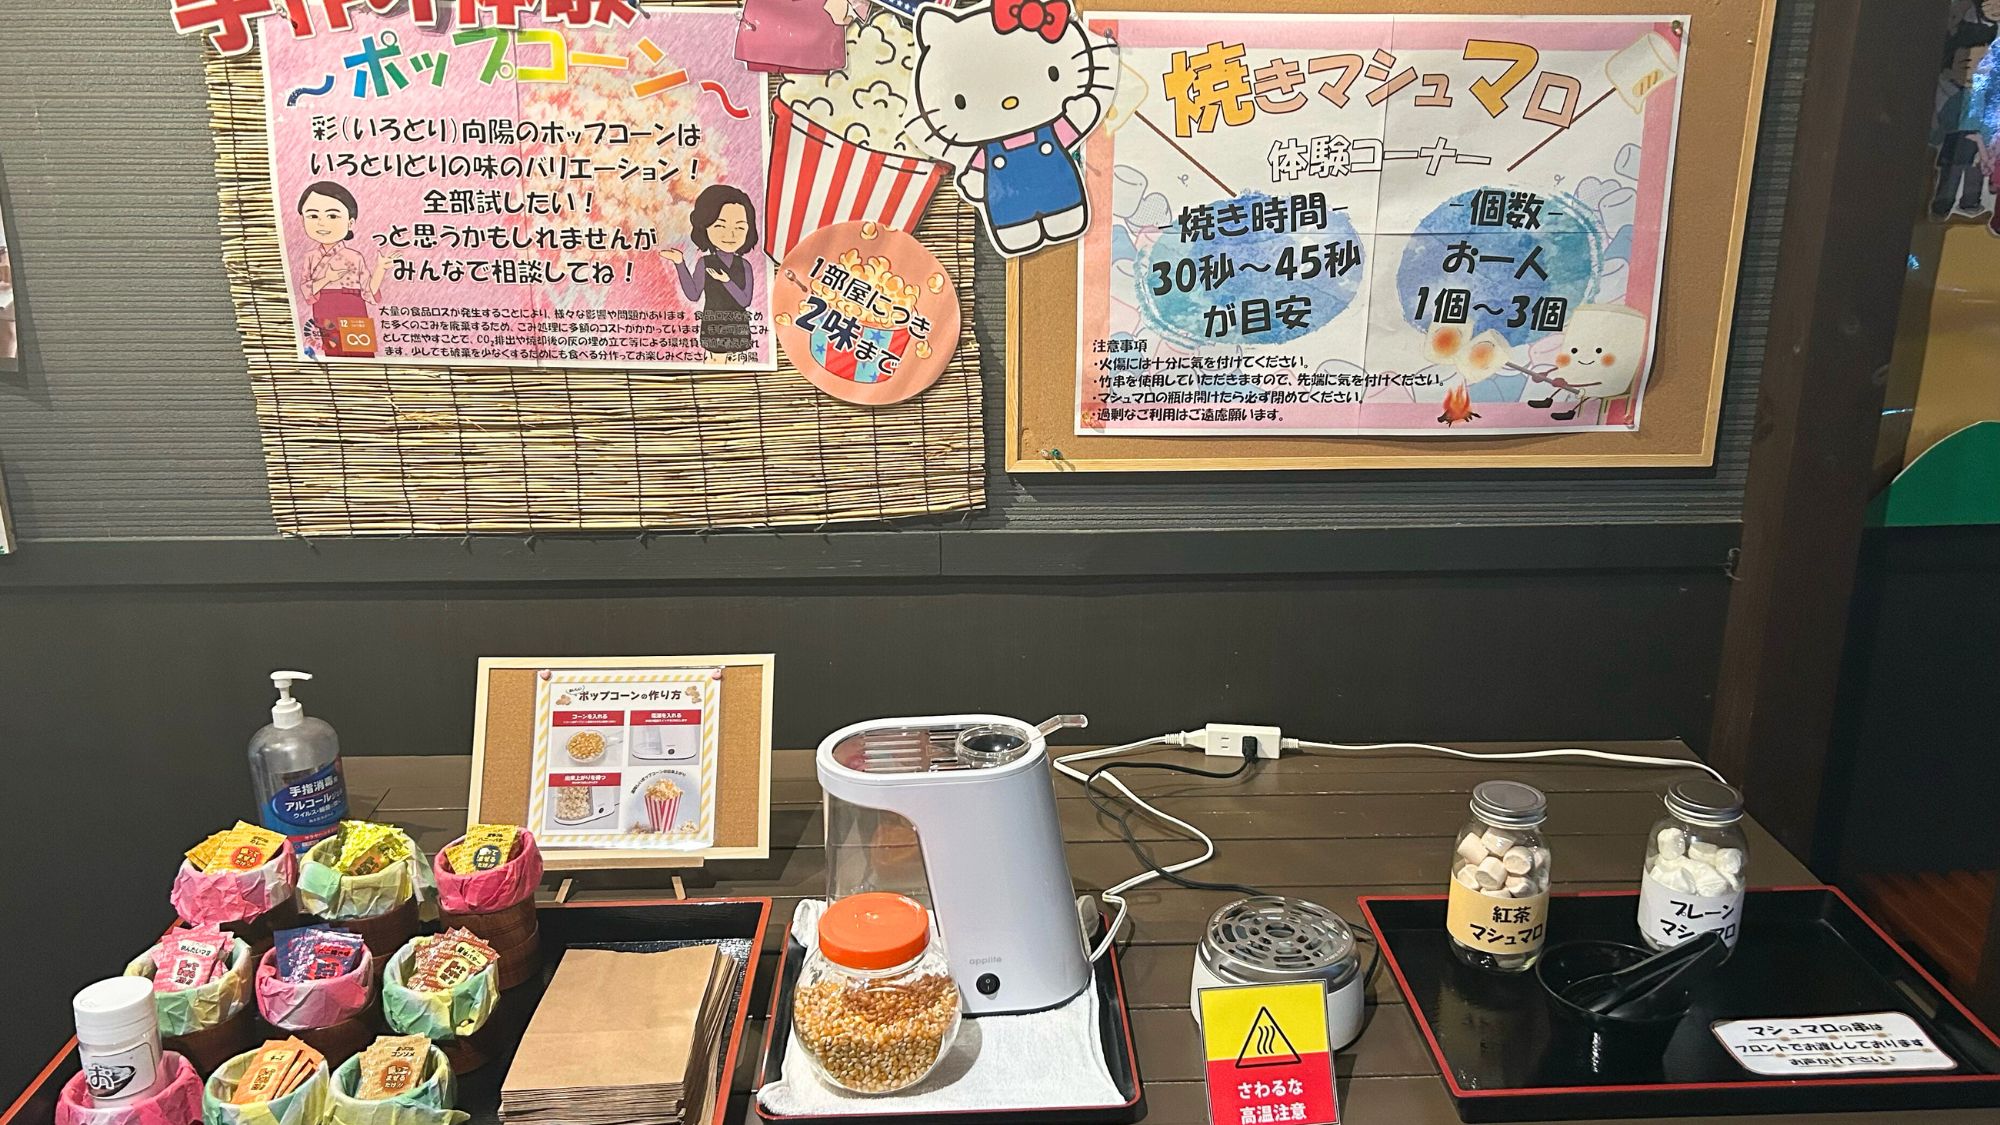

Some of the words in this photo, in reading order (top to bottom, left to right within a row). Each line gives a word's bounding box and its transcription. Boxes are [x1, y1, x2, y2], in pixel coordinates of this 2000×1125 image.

[1161, 38, 1582, 138] 焼きマシュマロ
[1267, 133, 1492, 183] 体験コーナー
[423, 189, 593, 215] 全部試したい！
[372, 223, 657, 251] っと思うかもしれませんが
[392, 258, 633, 284] みんなで相談してね！
[1442, 240, 1549, 282] お一人
[809, 257, 932, 341] 1部屋につき
[1203, 294, 1313, 338] が目安
[795, 295, 901, 375] 2味まで
[1092, 339, 1148, 353] 注意事項
[579, 690, 682, 701] ポップコーンの作り方
[1492, 905, 1532, 924] 紅茶
[1670, 899, 1735, 920] プレーン
[1469, 922, 1543, 946] マシュマロ
[1659, 918, 1736, 941] マシマロ
[1747, 1022, 1884, 1037] マシュマロの串は
[1237, 1078, 1304, 1099] さわるな
[1239, 1101, 1308, 1125] 高温注意
